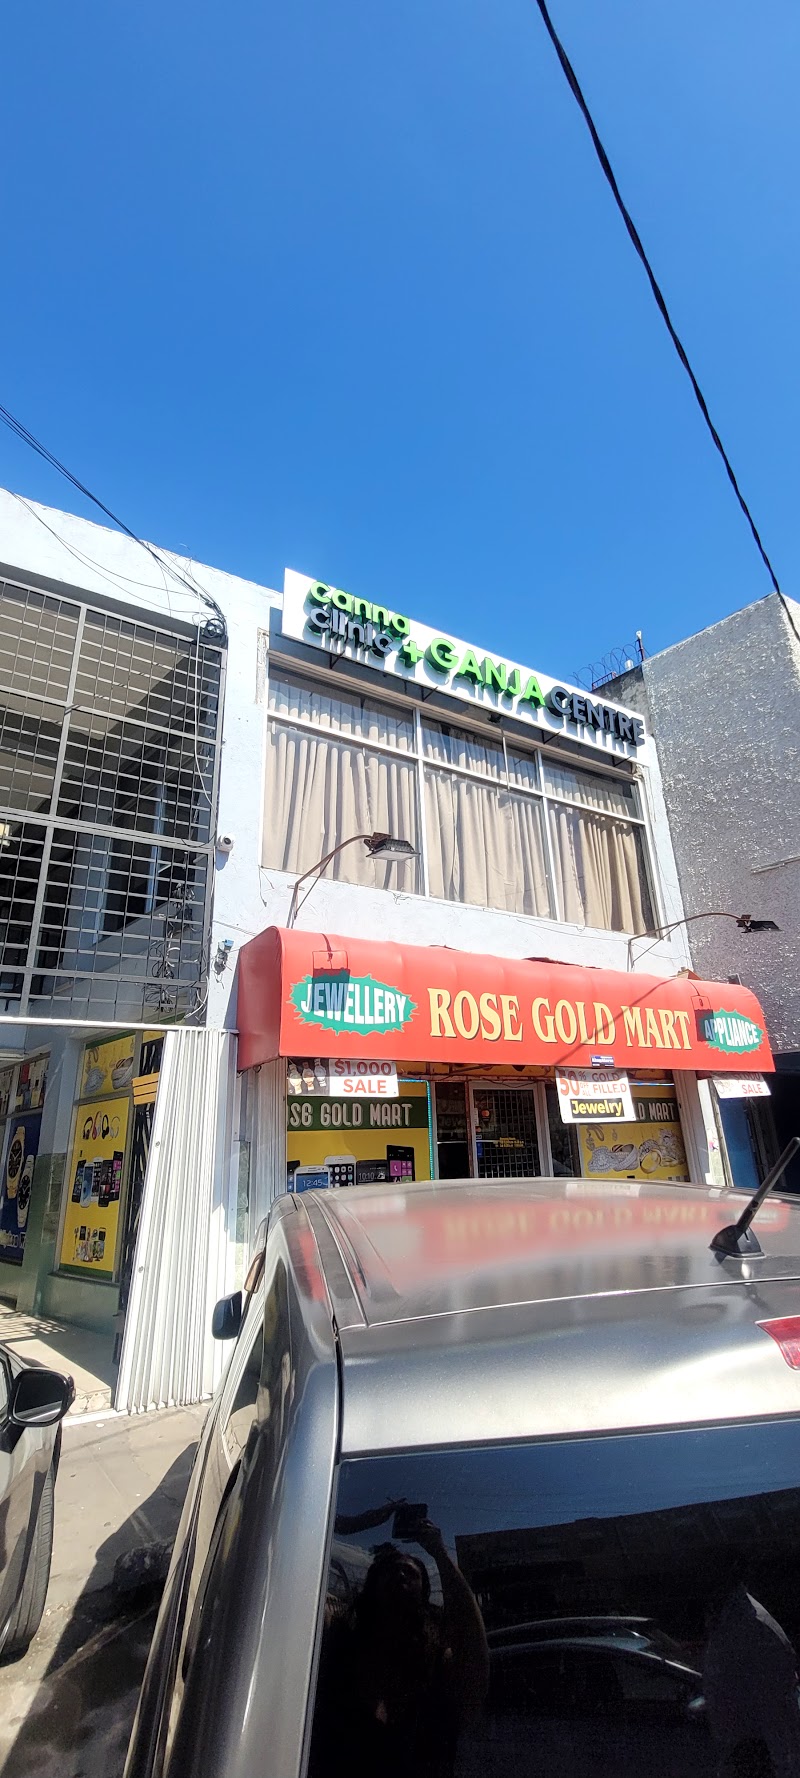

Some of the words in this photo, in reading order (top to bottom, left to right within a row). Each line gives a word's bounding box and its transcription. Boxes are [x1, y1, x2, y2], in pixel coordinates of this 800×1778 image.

[310, 580, 410, 637] canna
[309, 607, 394, 653] clinic
[429, 637, 546, 707] GANJA
[549, 685, 646, 748] CENTRE
[300, 982, 407, 1025] JEWELLERY
[427, 987, 523, 1042] ROSE
[531, 997, 616, 1046] GOLD
[621, 1005, 692, 1050] MART
[704, 1016, 760, 1048] APPLIANCE
[334, 1058, 392, 1077] $1,000
[343, 1078, 388, 1094] SALE
[591, 1072, 620, 1083] GOLD
[592, 1083, 628, 1094] FILLED
[741, 1083, 764, 1095] SALE
[320, 1102, 363, 1127] GOLD
[370, 1102, 413, 1127] MART
[571, 1099, 623, 1117] Jewelry
[648, 1102, 675, 1121] MART
[302, 1178, 323, 1188] 12:45
